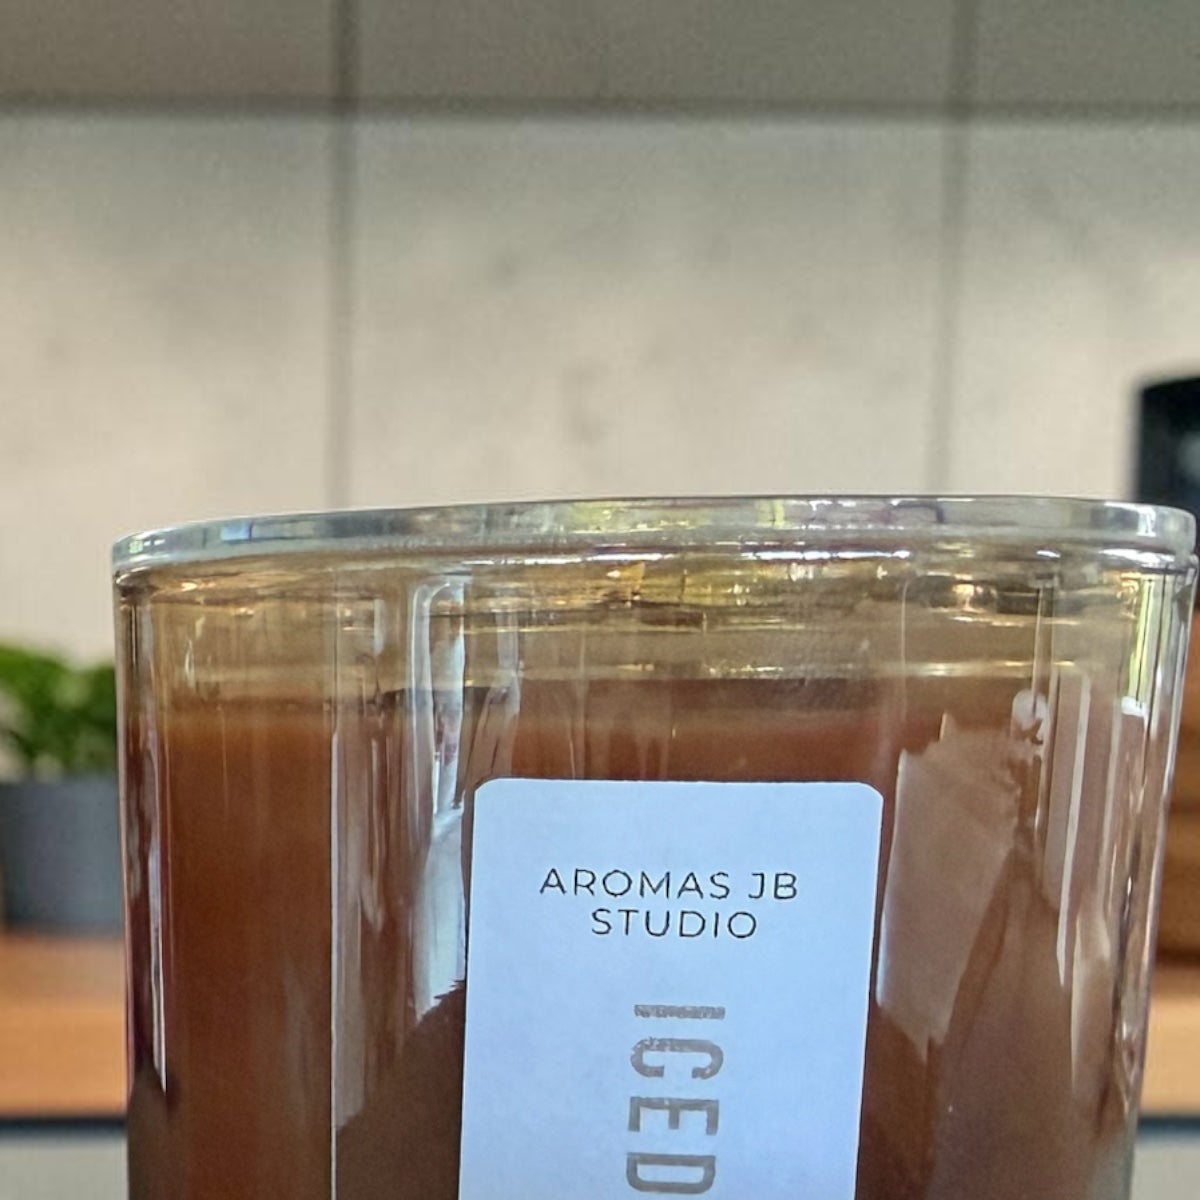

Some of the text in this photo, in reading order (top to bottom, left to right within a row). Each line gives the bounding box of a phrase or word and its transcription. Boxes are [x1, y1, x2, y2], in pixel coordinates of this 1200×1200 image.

[539, 868, 798, 900] AROMAS JB
[591, 908, 757, 939] STUDIO
[626, 1004, 726, 1194] ICED
